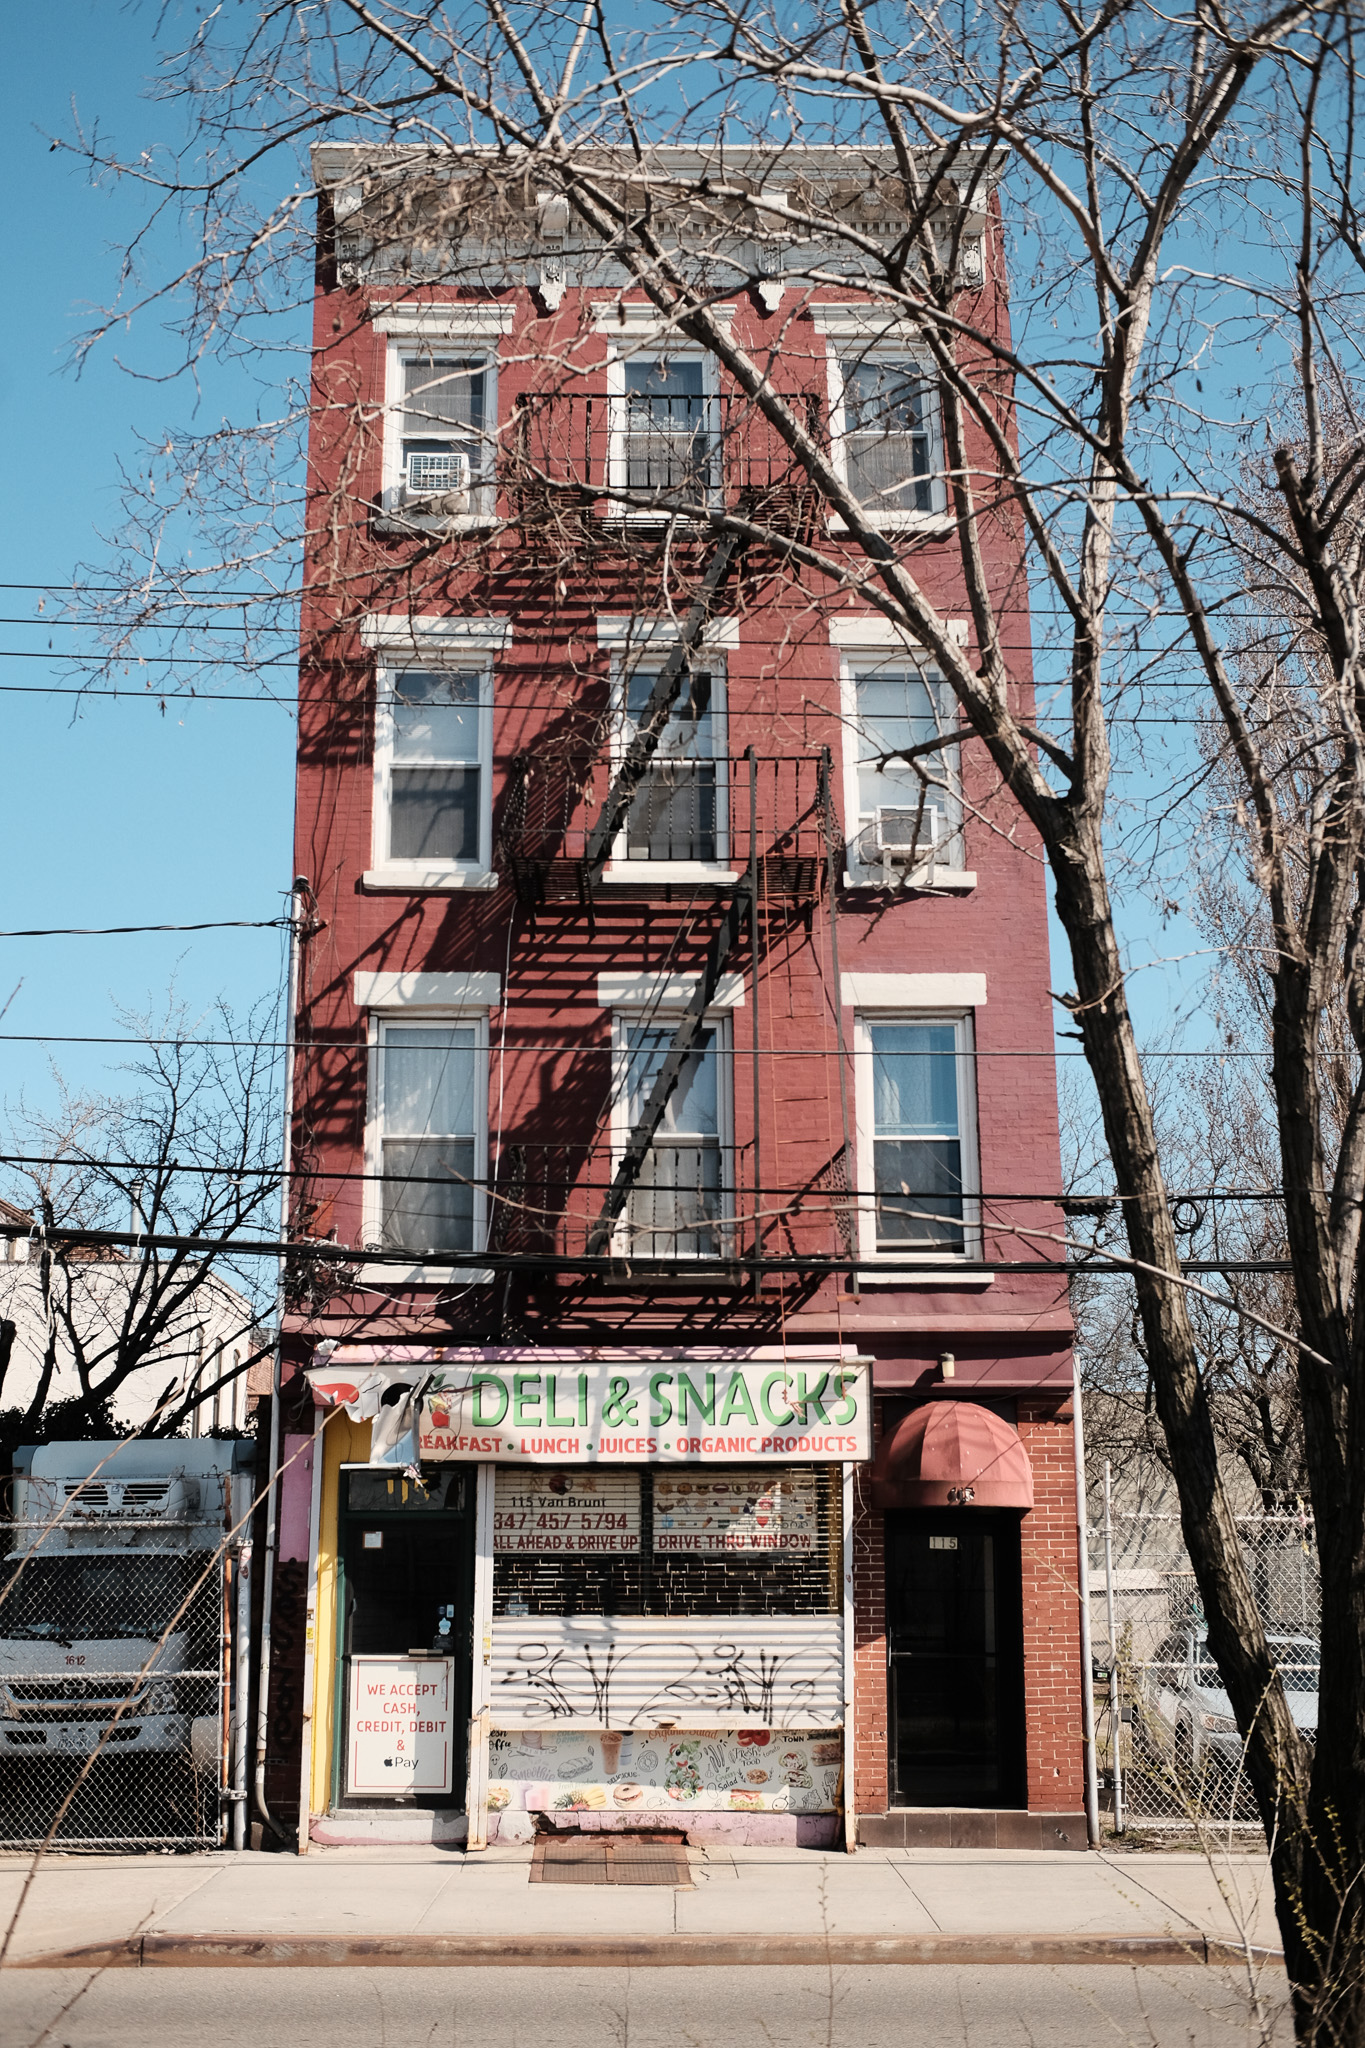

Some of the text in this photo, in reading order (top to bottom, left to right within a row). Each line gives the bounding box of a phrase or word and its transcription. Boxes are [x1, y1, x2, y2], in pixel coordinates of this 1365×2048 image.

[472, 1371, 858, 1428] DELI & SNACKS
[419, 1434, 857, 1454] REAKFAST LUNCH JUICES ORGANIC PRODUCTS
[511, 1497, 607, 1508] 115 Van Brunt
[494, 1512, 628, 1530] 347-457-5794
[494, 1535, 638, 1549] ALL AHEAD & DRIVE UP
[658, 1535, 811, 1549] DRIVE THRU WINDOW
[932, 1537, 957, 1549] 115
[65, 1655, 86, 1665] 1612
[367, 1684, 438, 1696] WE ACCEPT
[383, 1702, 421, 1717] CASH,
[357, 1720, 447, 1735] CREDIT, DEBIT
[396, 1739, 405, 1751] &
[782, 1735, 804, 1743] TOWN
[395, 1756, 419, 1770] Pay
[718, 1778, 739, 1792] Salad
